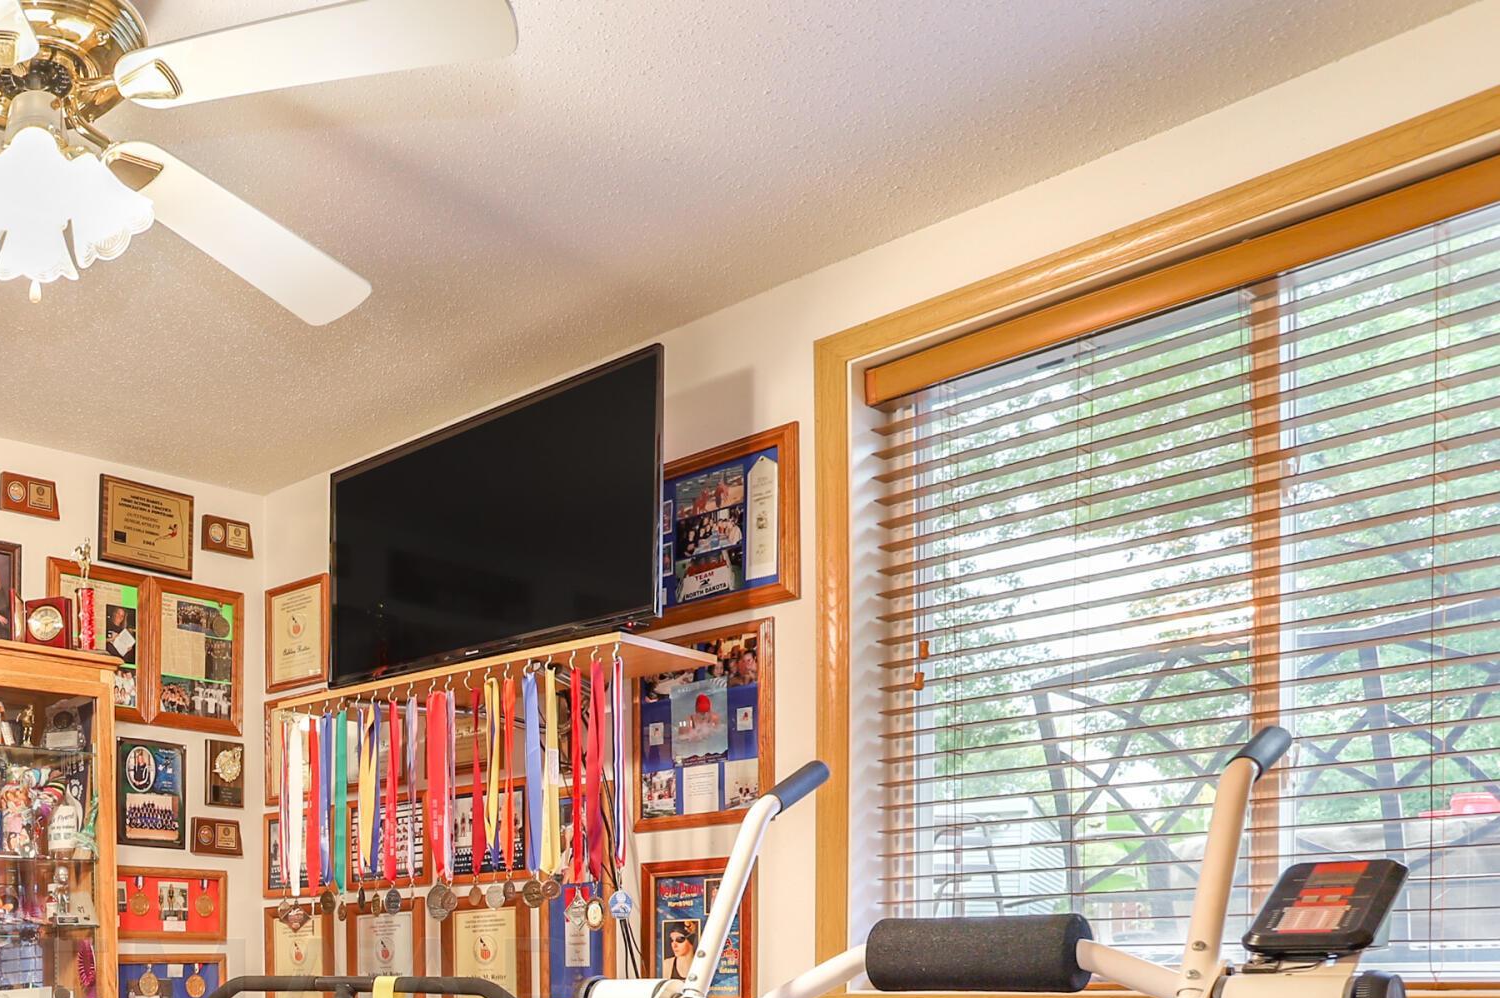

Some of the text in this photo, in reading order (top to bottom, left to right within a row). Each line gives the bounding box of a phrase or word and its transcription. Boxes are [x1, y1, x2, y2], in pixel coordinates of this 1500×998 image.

[694, 570, 715, 582] TEAM
[685, 582, 727, 600] NORTH DAKOTA
